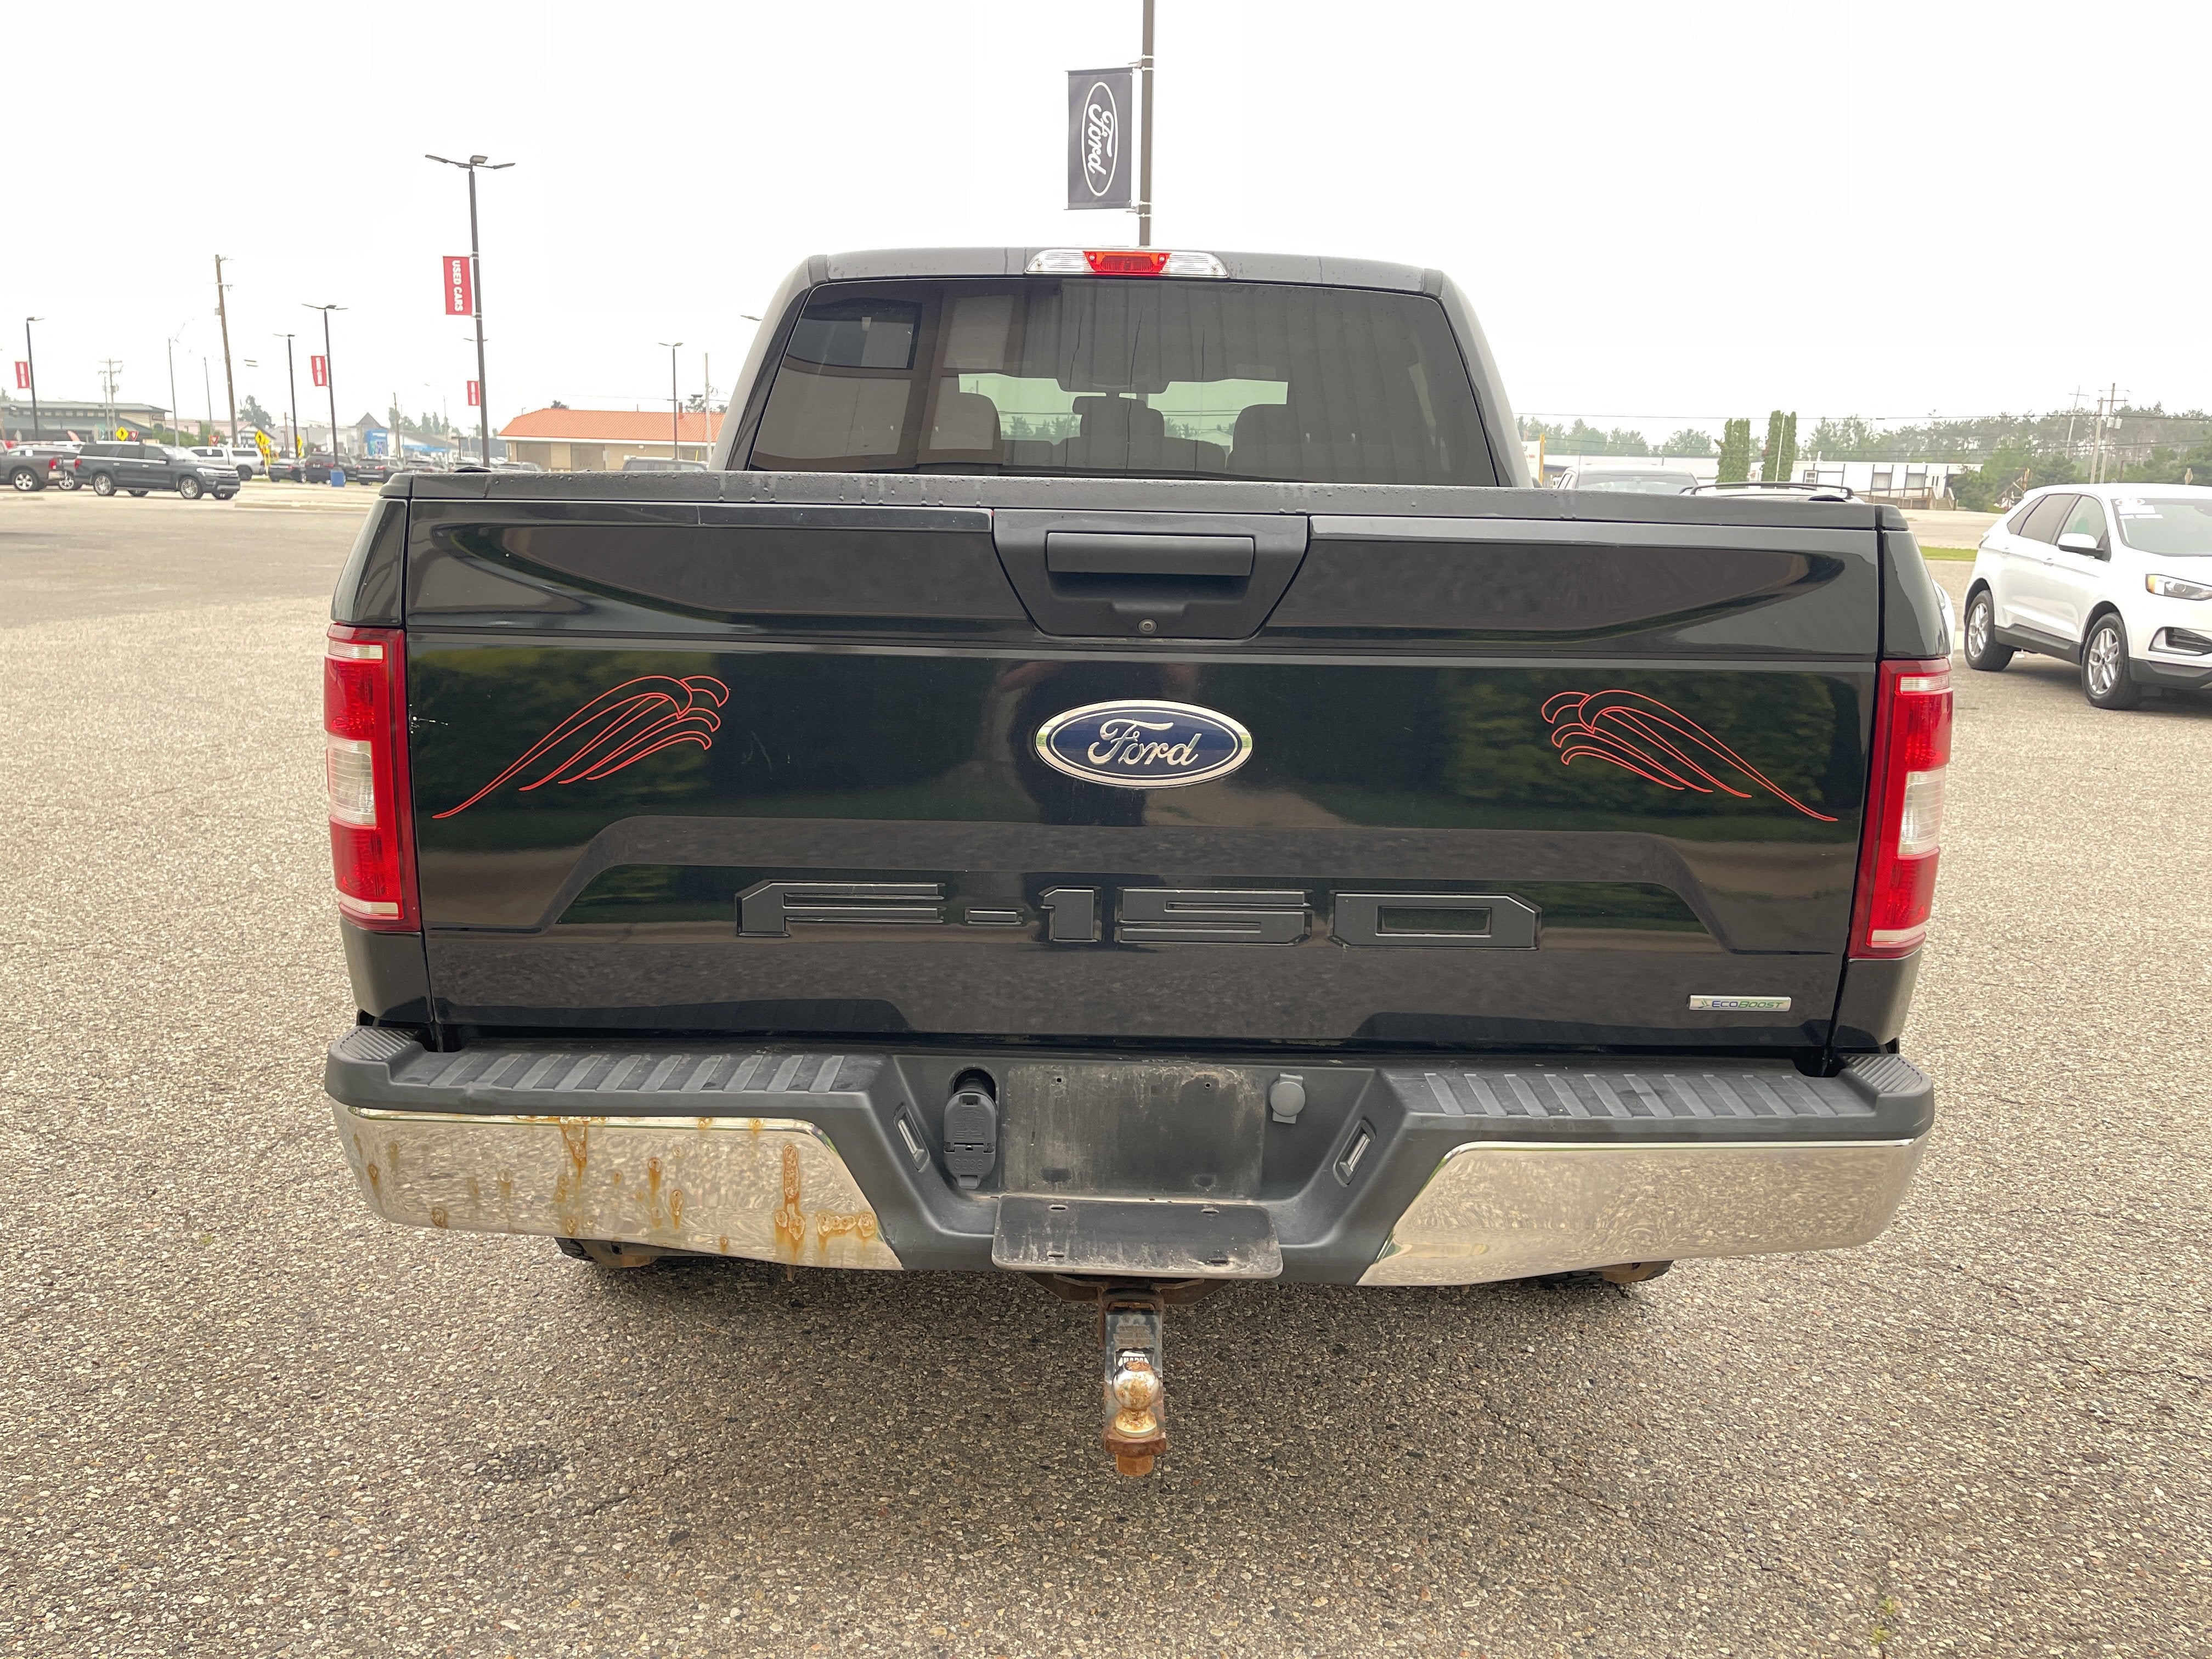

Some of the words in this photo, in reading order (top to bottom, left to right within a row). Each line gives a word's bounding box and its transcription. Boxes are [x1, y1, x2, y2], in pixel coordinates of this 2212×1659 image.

[1087, 104, 1113, 175] Ford
[452, 260, 462, 285] USED
[454, 286, 464, 312] CARS
[1087, 719, 1202, 766] Ford
[736, 880, 1542, 950] F-150
